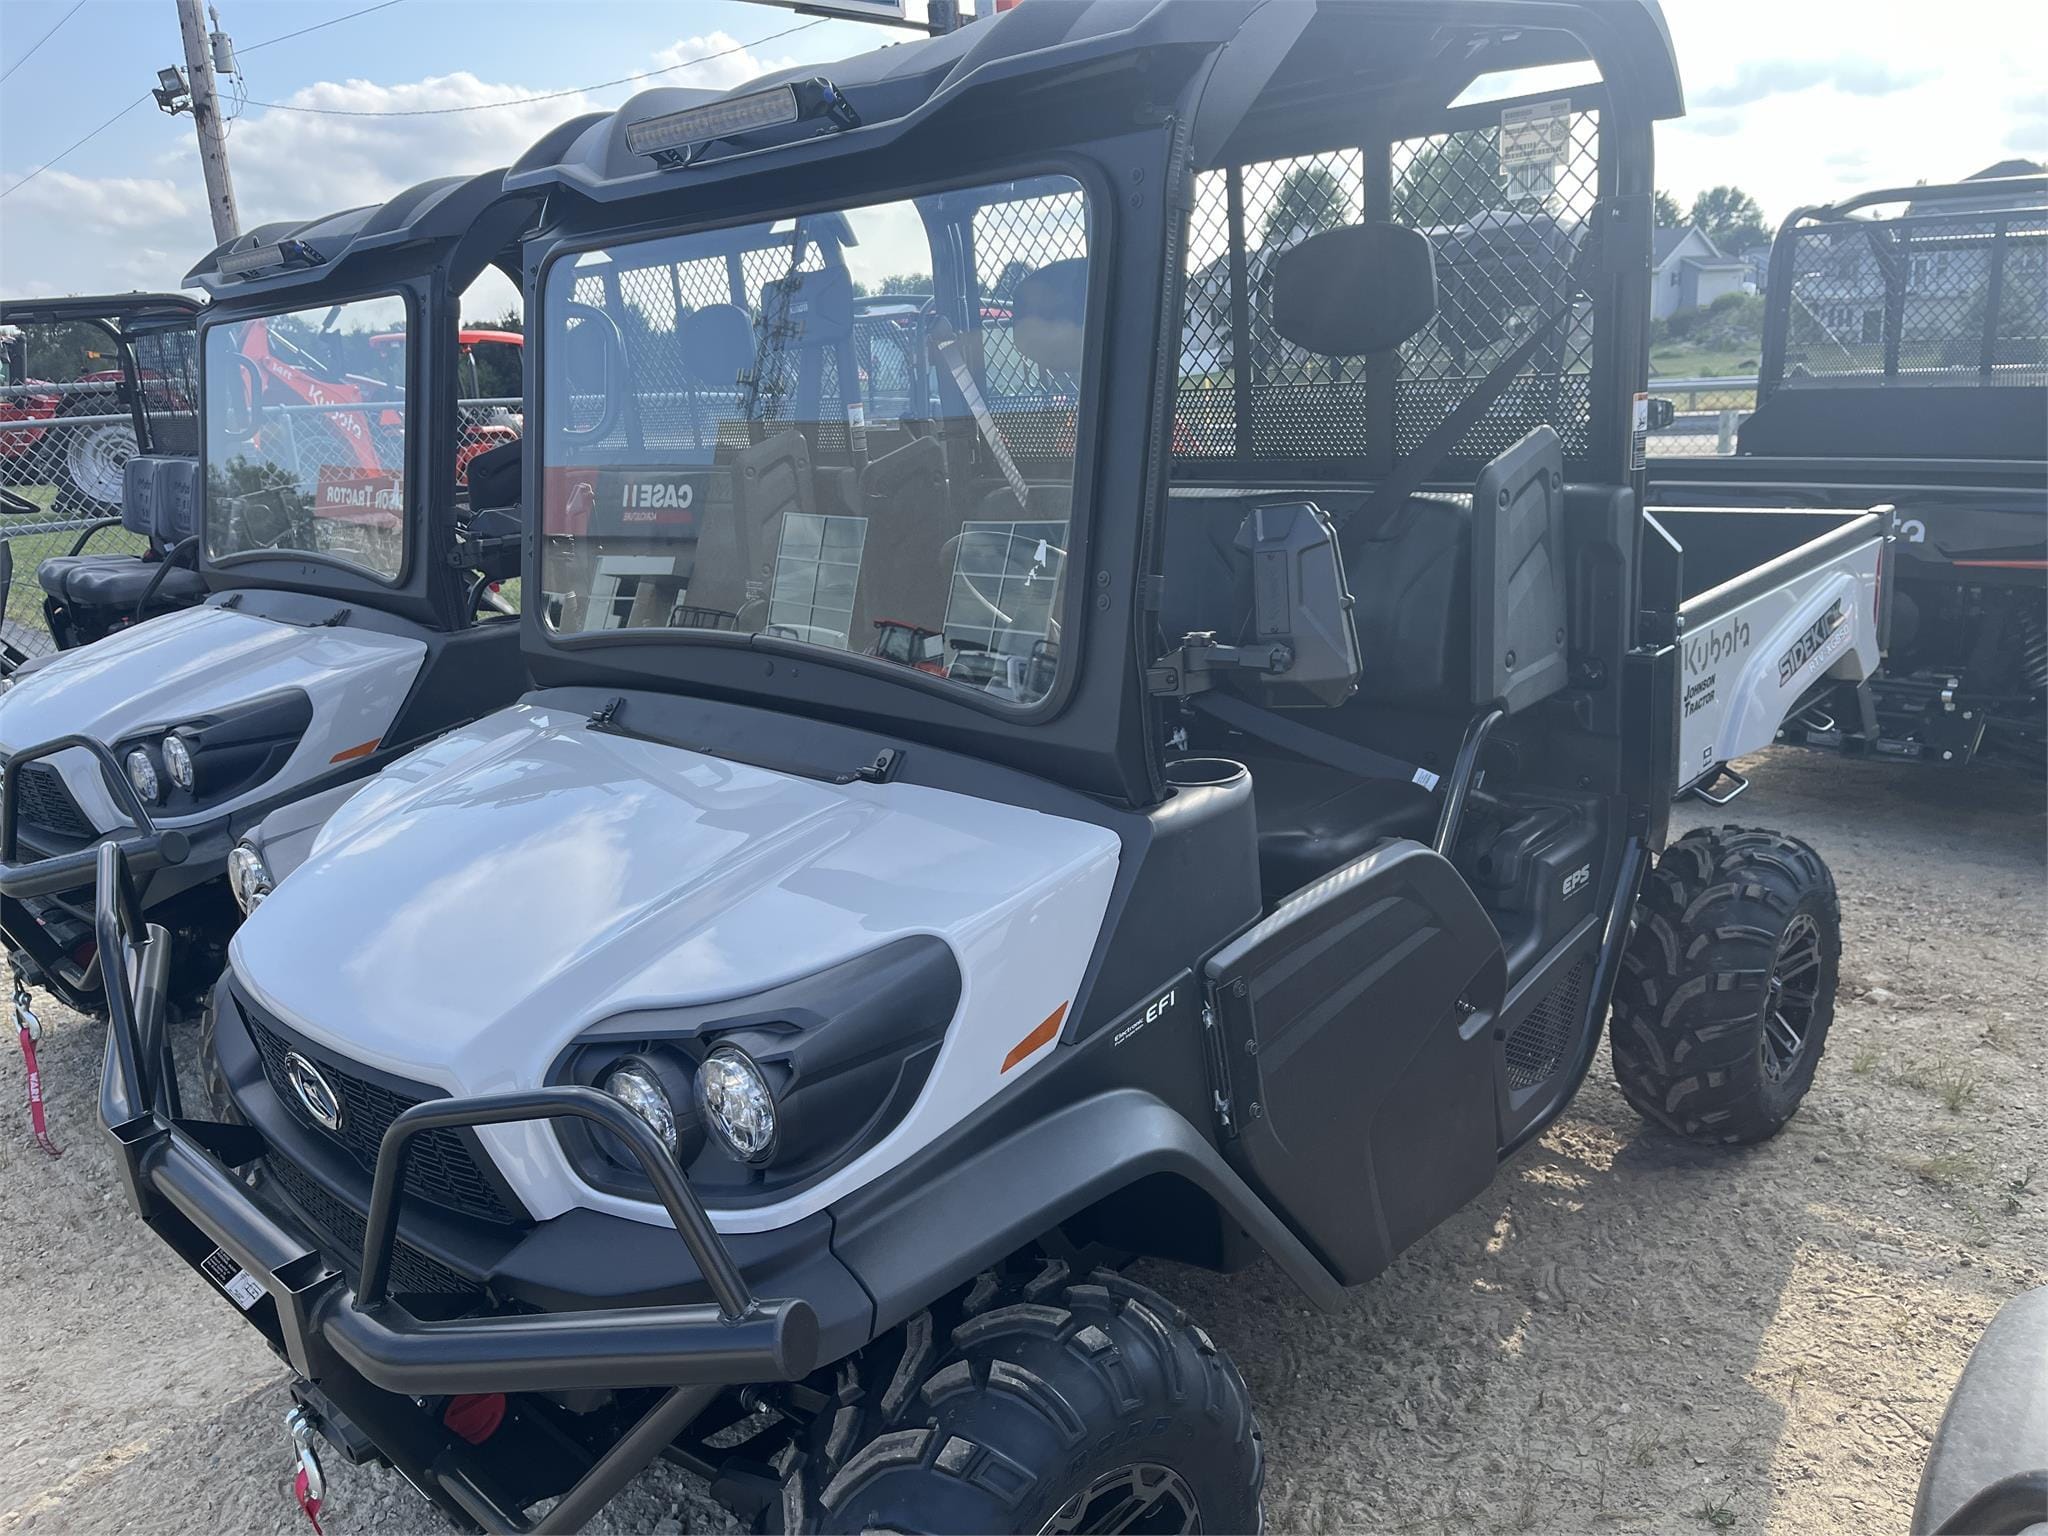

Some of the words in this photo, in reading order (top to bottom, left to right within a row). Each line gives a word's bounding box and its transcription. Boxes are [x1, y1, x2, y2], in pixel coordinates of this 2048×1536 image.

[1684, 616, 1750, 676] Kubota
[1683, 673, 1716, 702] JOHNSON
[1684, 690, 1716, 718] TRACTOR
[1562, 863, 1590, 895] EPS
[1146, 990, 1175, 1023] EFI
[29, 1071, 41, 1103] WARN
